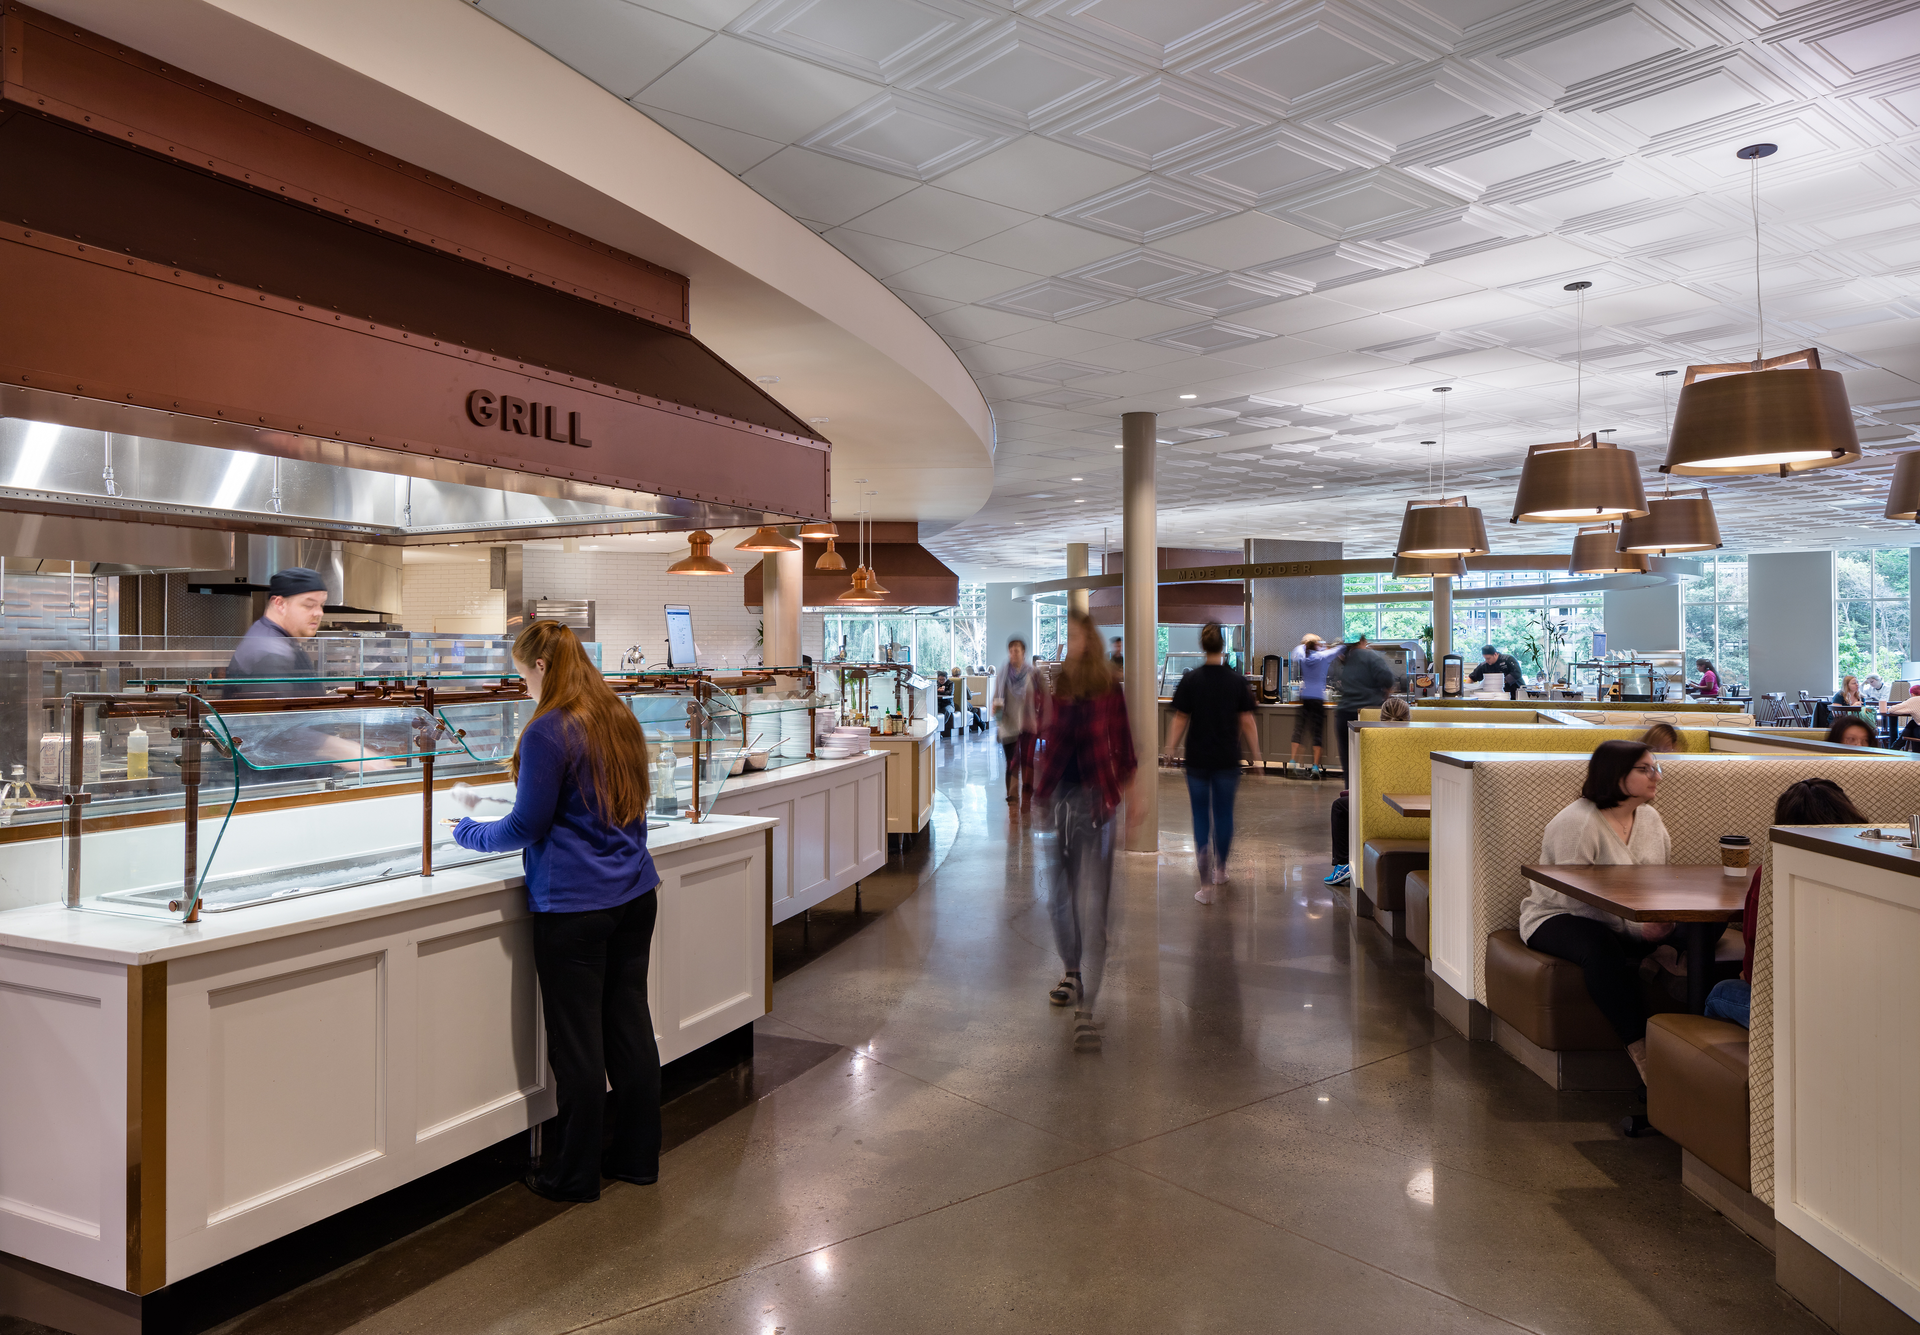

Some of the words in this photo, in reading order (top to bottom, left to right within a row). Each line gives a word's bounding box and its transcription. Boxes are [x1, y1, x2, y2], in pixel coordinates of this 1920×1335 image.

[465, 388, 592, 448] GRILL
[1177, 568, 1216, 580] MADE
[1225, 566, 1244, 577] TO
[1253, 564, 1312, 575] ORDER
